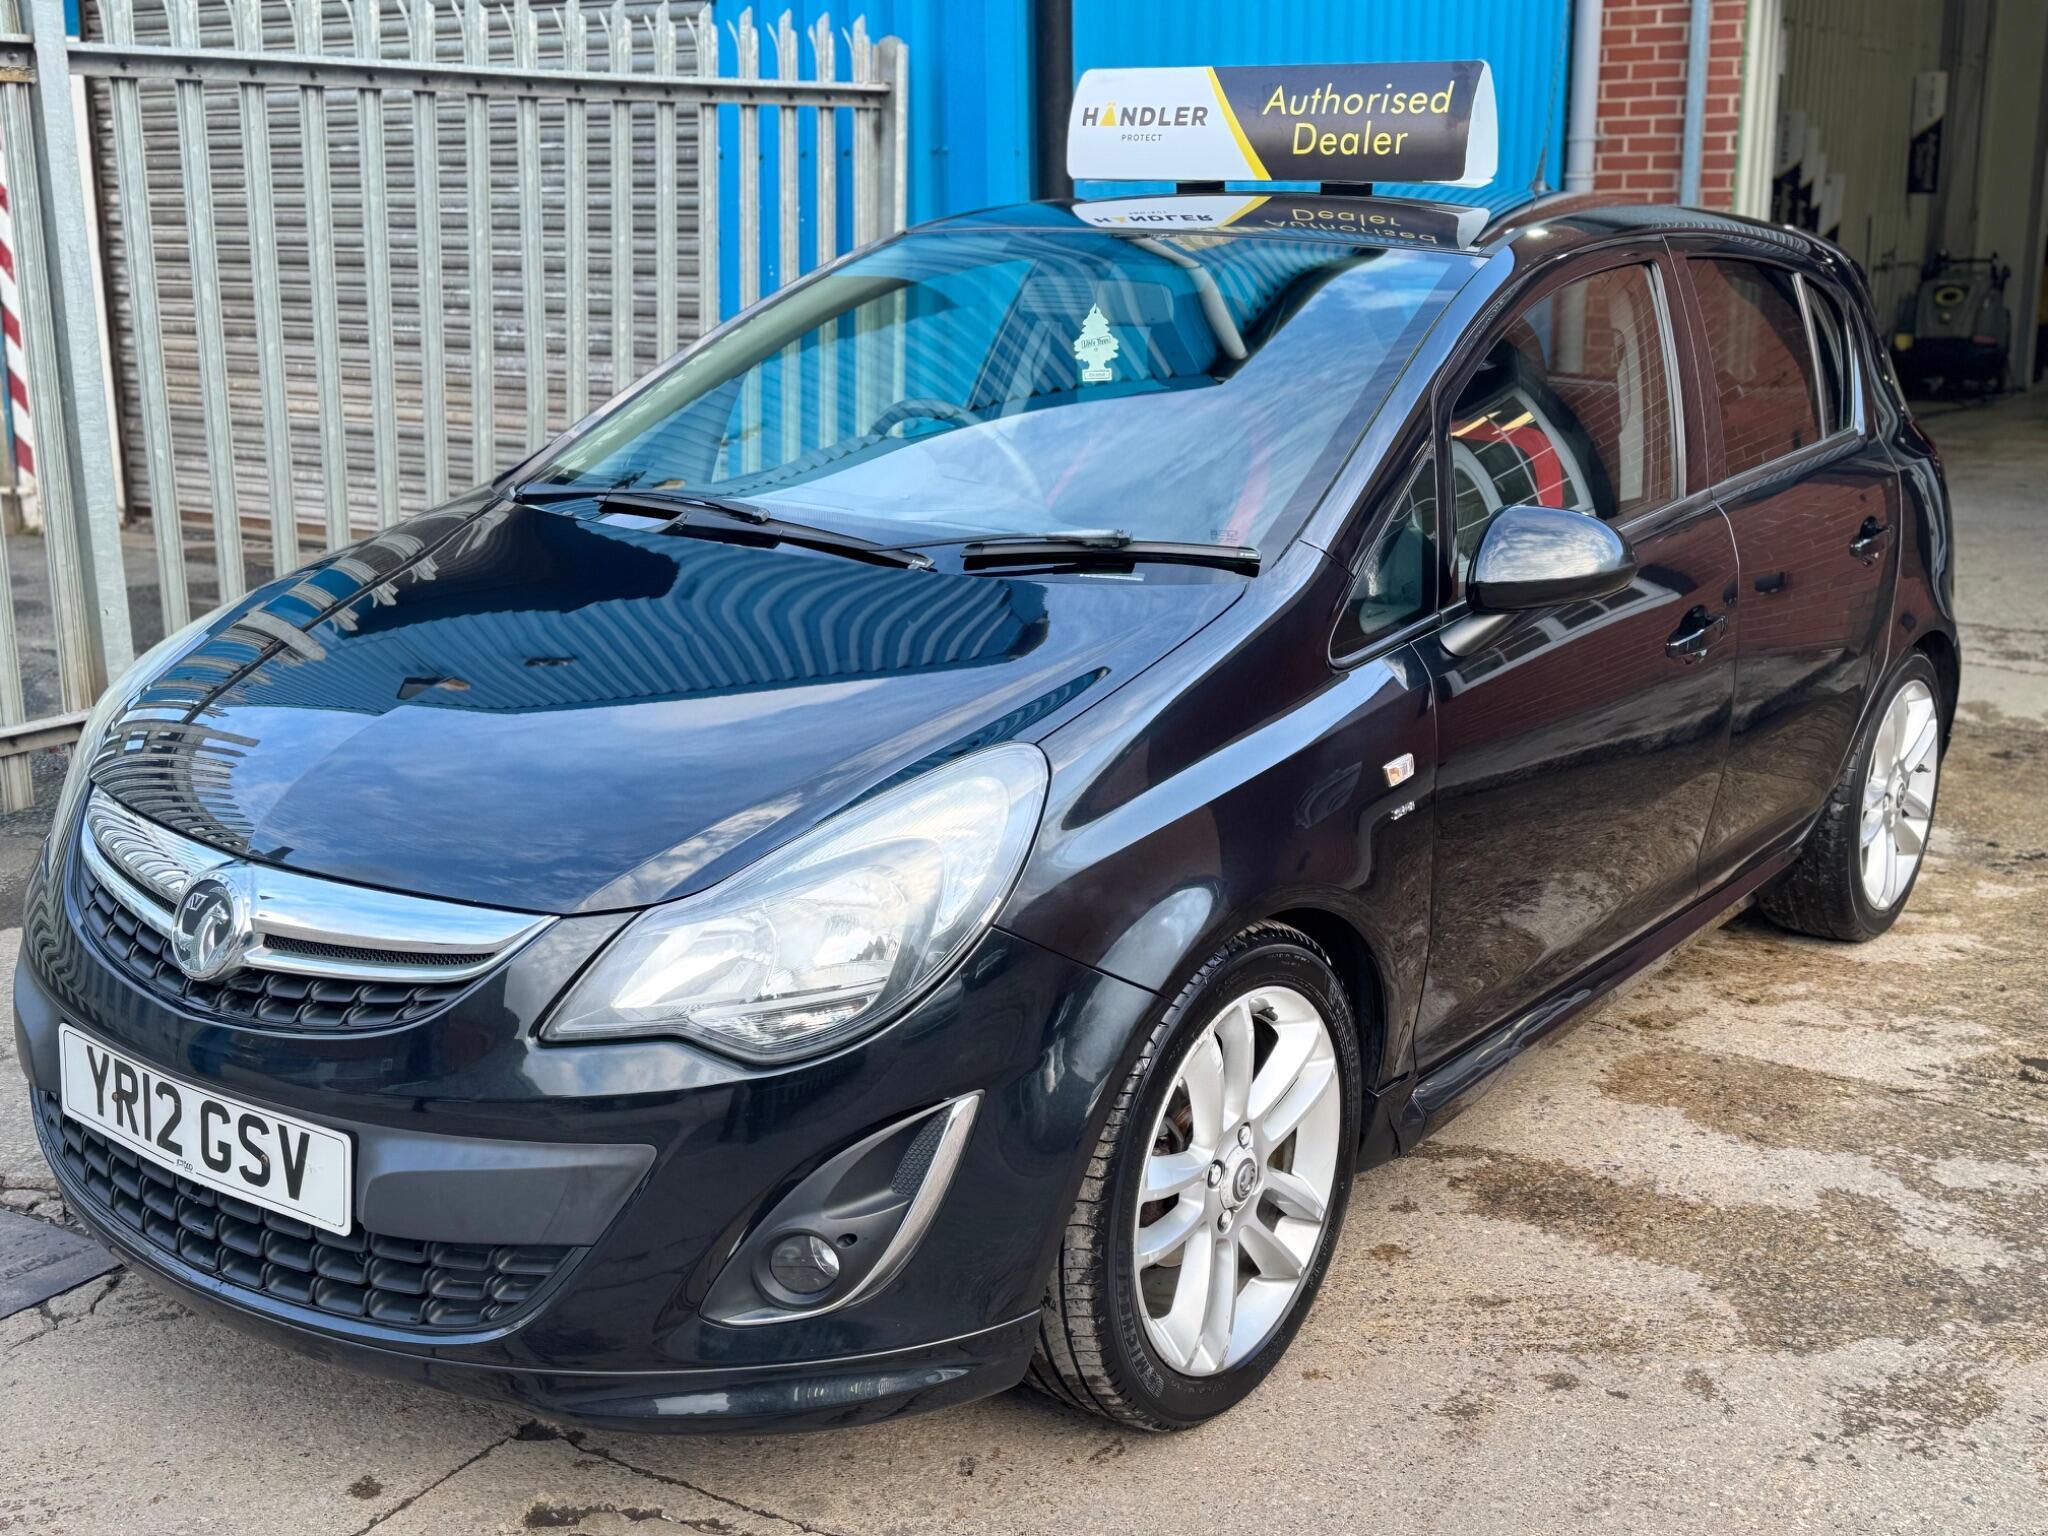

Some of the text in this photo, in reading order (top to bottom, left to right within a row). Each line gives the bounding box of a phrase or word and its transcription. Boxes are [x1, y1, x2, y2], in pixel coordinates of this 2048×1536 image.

[1263, 81, 1455, 116] Authorised
[1121, 133, 1162, 142] PROTECT
[1292, 121, 1408, 155] Dealer
[86, 1045, 311, 1201] YR12 GSV
